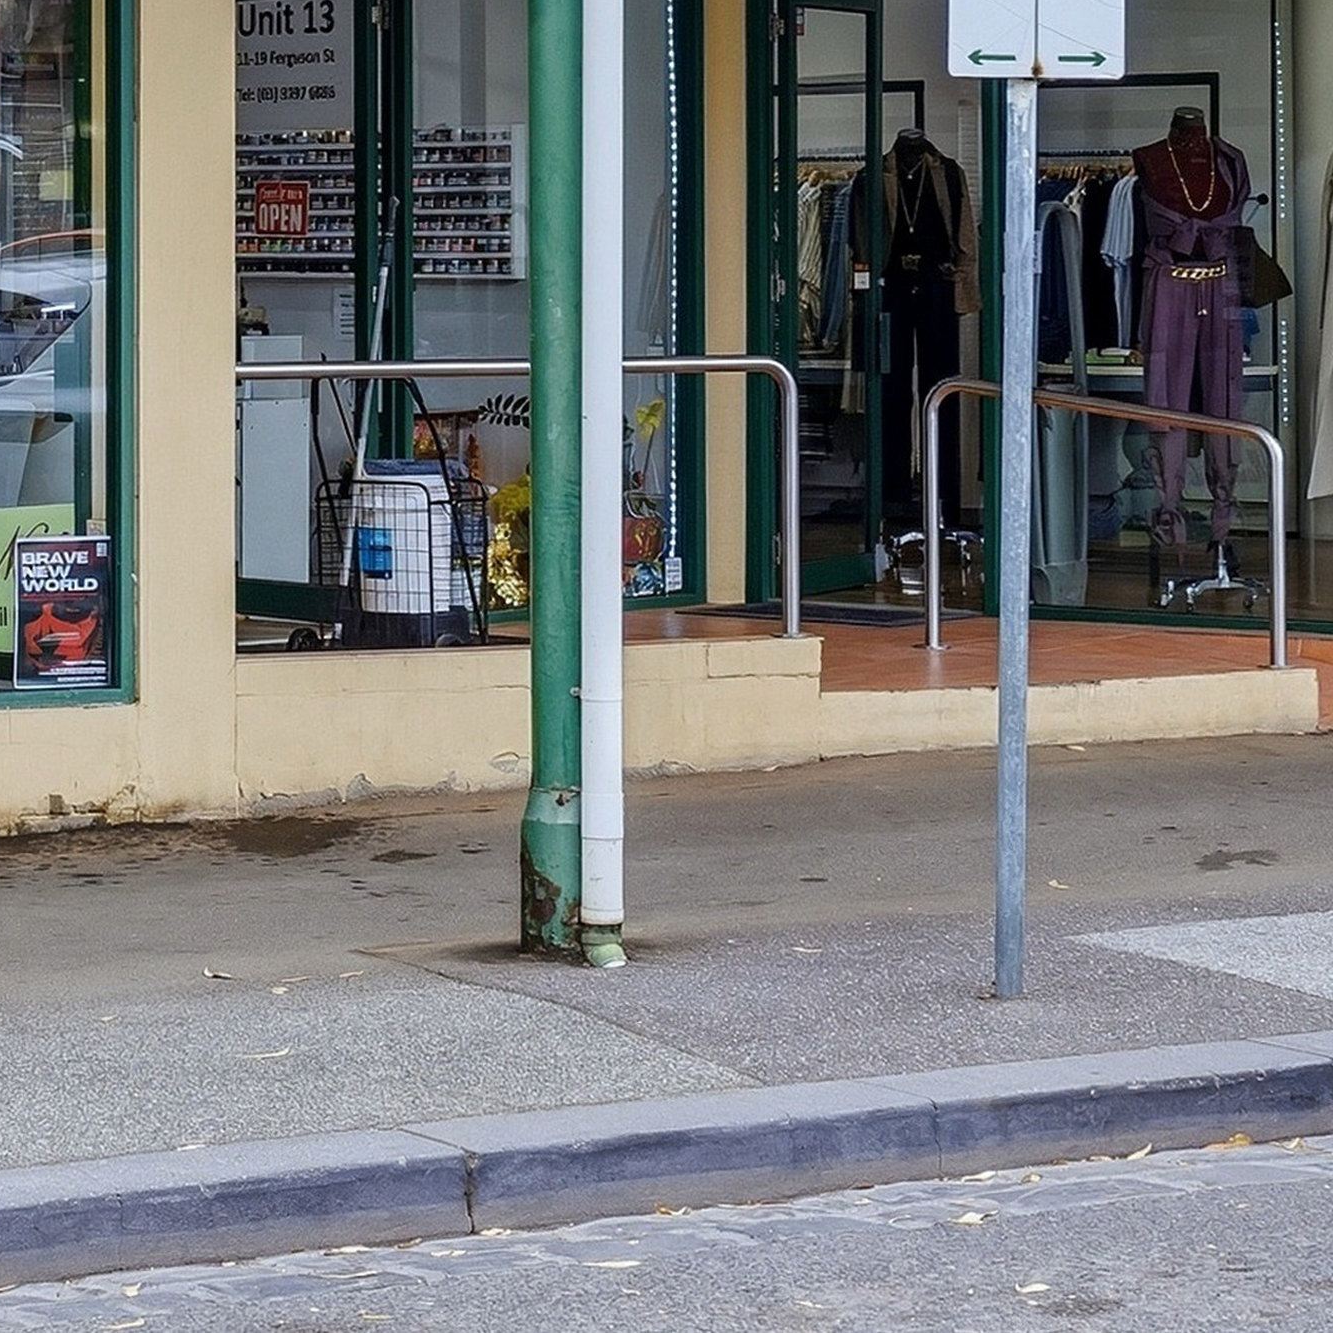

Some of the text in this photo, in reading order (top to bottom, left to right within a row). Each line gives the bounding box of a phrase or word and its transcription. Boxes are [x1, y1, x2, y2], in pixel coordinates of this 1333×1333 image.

[238, 0, 334, 37] Unit 13
[259, 203, 303, 232] OPEN
[21, 550, 89, 565] BRAVE
[21, 565, 71, 578] NEW
[21, 578, 99, 592] WORLD
